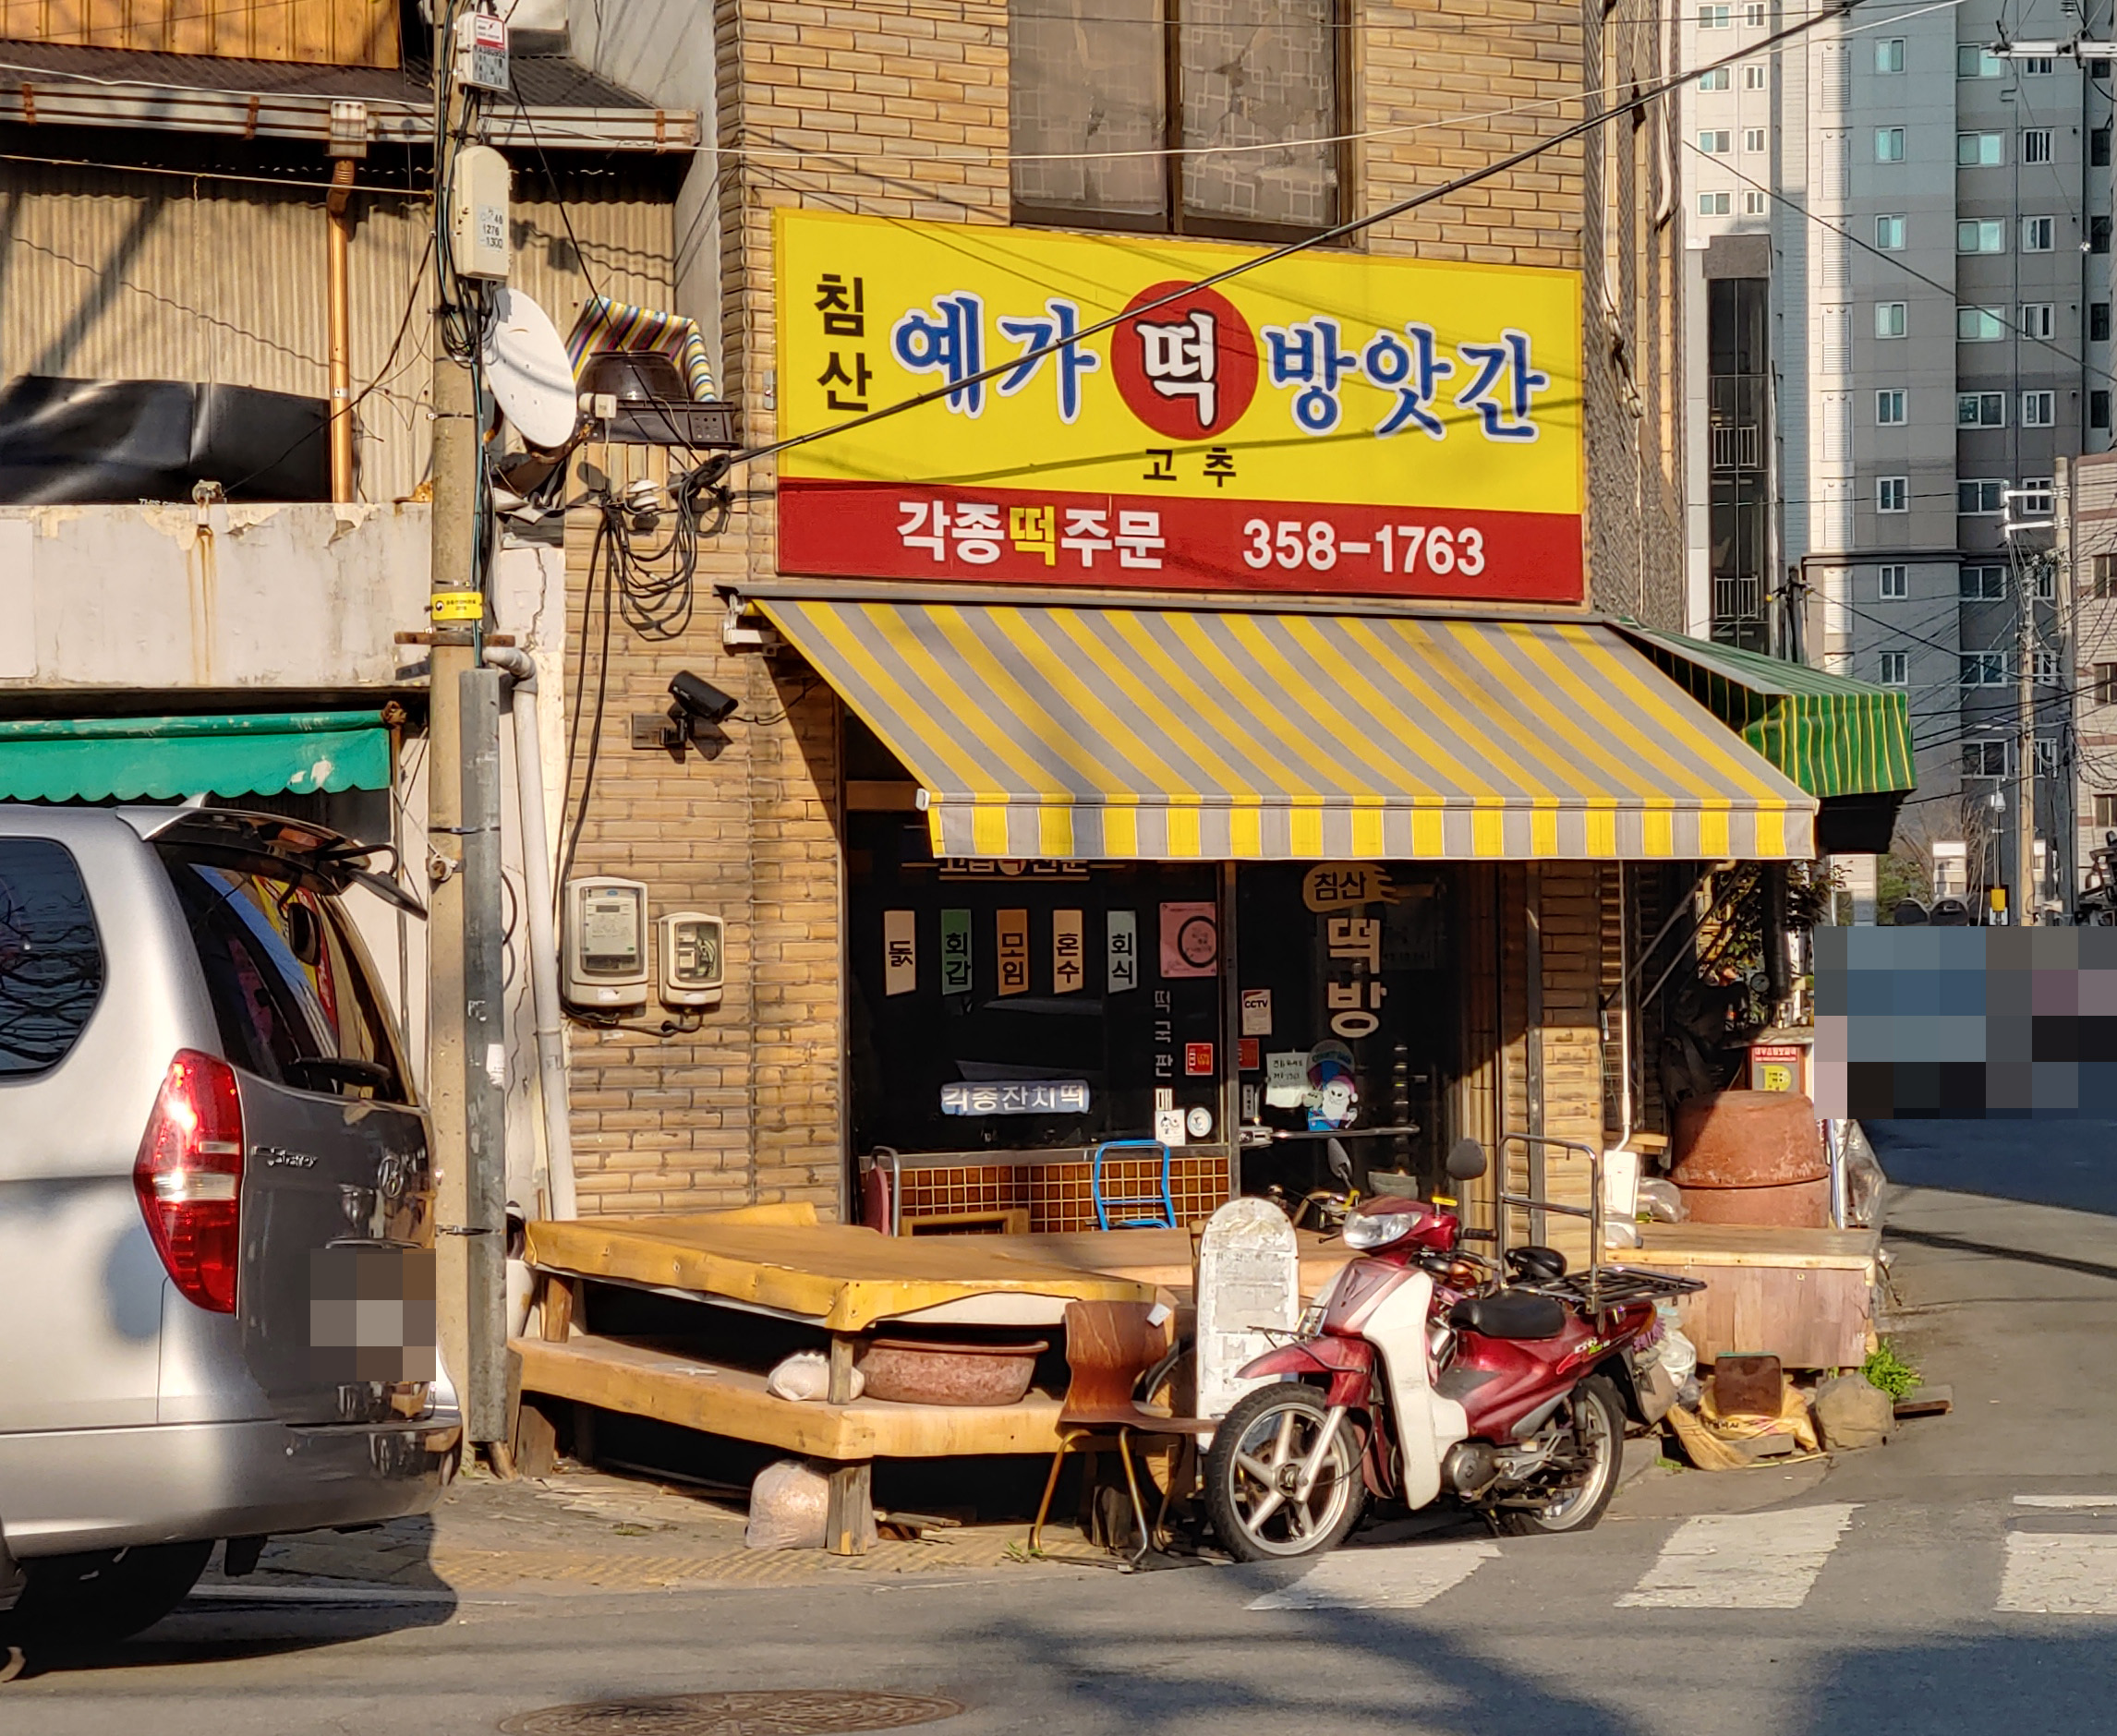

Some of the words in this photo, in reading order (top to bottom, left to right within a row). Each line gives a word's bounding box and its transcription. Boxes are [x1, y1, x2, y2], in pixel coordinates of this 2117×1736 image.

[814, 273, 873, 412] 침산
[1143, 447, 1237, 488] 고추
[1243, 518, 1485, 576] 358-1763
[1313, 871, 1366, 901] 침산
[945, 932, 971, 985] 회갑
[1000, 933, 1024, 985] 모임
[1056, 933, 1080, 983] 혼수
[1111, 932, 1133, 984] 회식
[1244, 1000, 1268, 1008] CCTV
[942, 1084, 1083, 1112] 각종잔치떡
